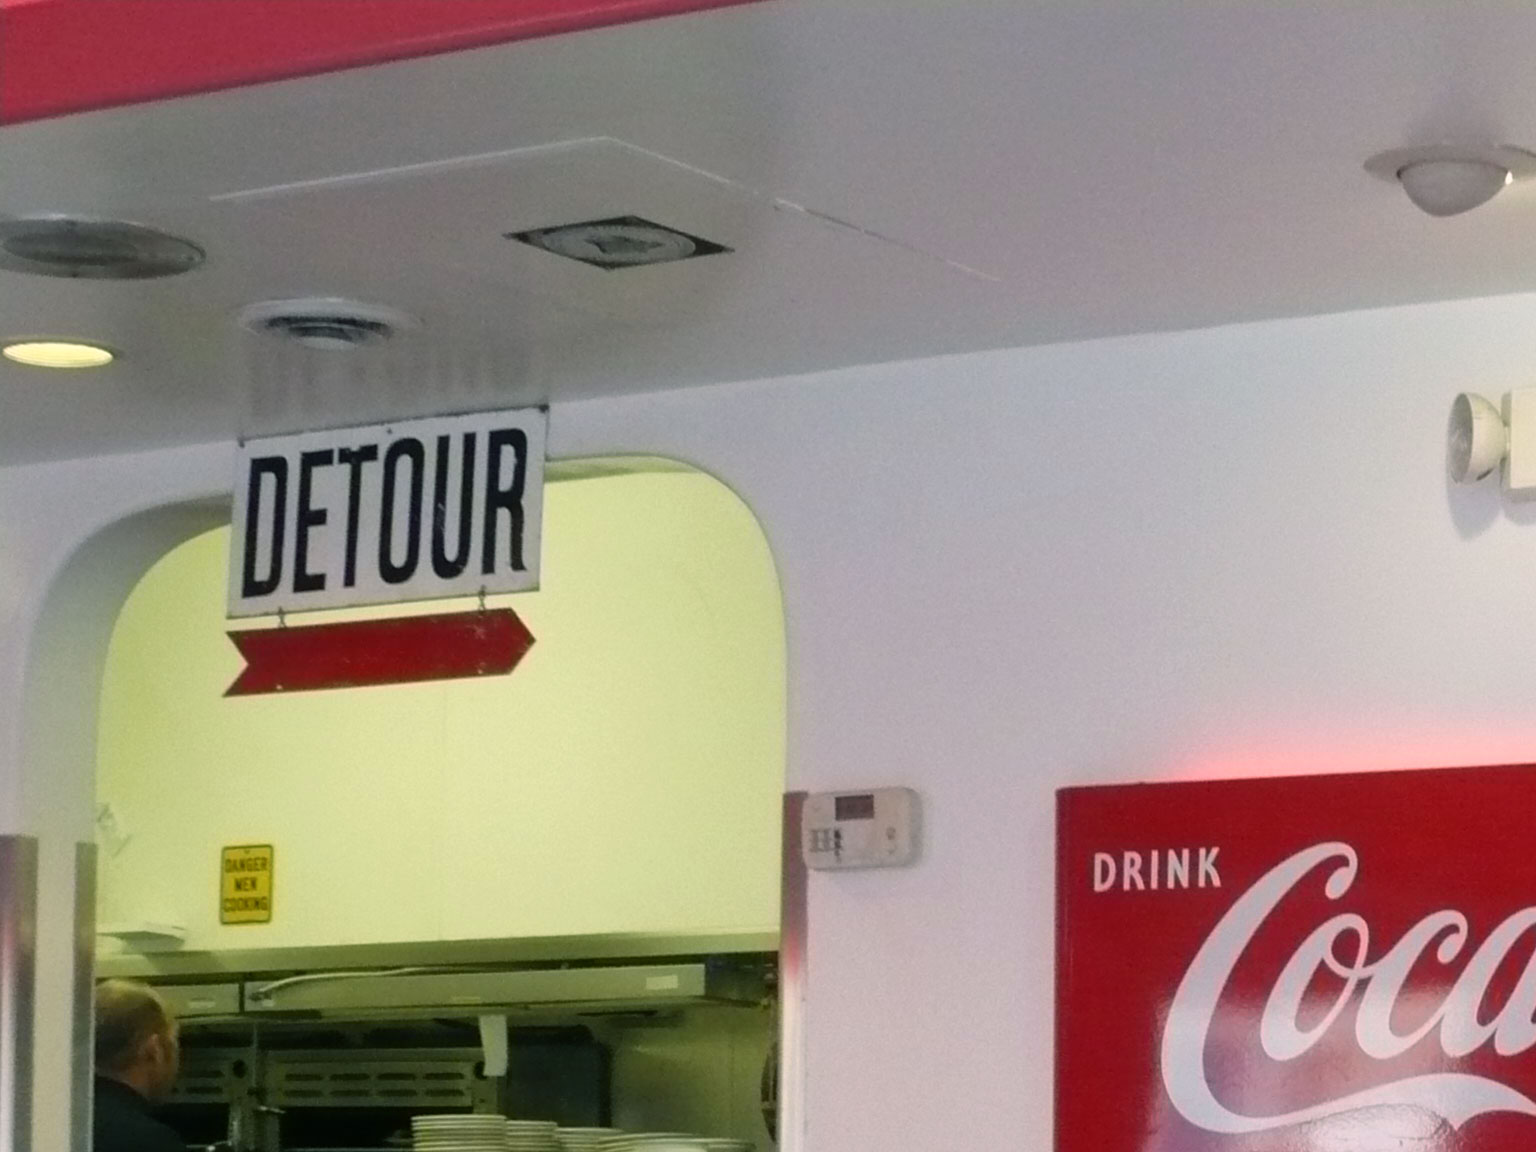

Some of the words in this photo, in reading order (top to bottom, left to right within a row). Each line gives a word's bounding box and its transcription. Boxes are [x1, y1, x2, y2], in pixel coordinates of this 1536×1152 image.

[242, 428, 528, 598] DETOUR
[225, 857, 268, 873] DANGER
[1093, 847, 1224, 894] DRINK
[234, 877, 257, 891] MEN
[224, 896, 268, 912] COOKING
